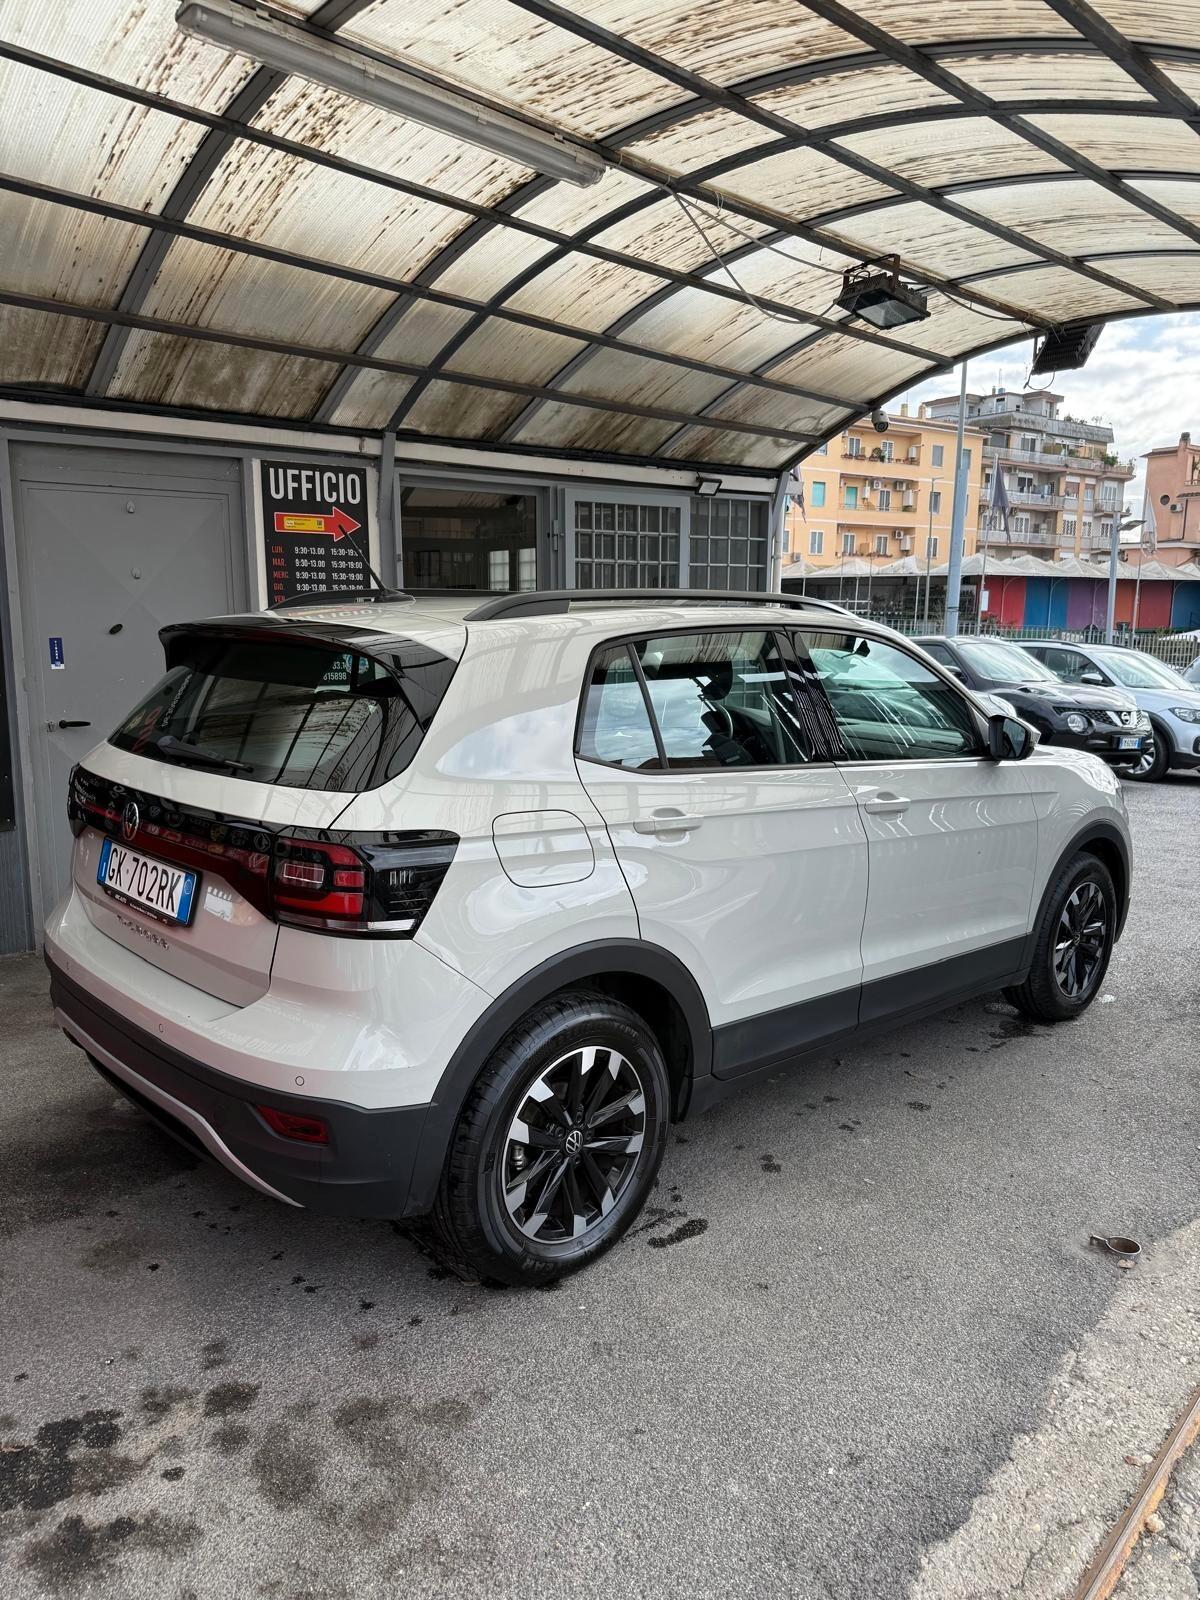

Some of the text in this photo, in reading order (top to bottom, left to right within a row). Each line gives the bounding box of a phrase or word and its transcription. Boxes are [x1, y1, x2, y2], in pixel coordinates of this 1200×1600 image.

[269, 468, 361, 504] UFFICIO
[108, 847, 182, 913] GK 702RK
